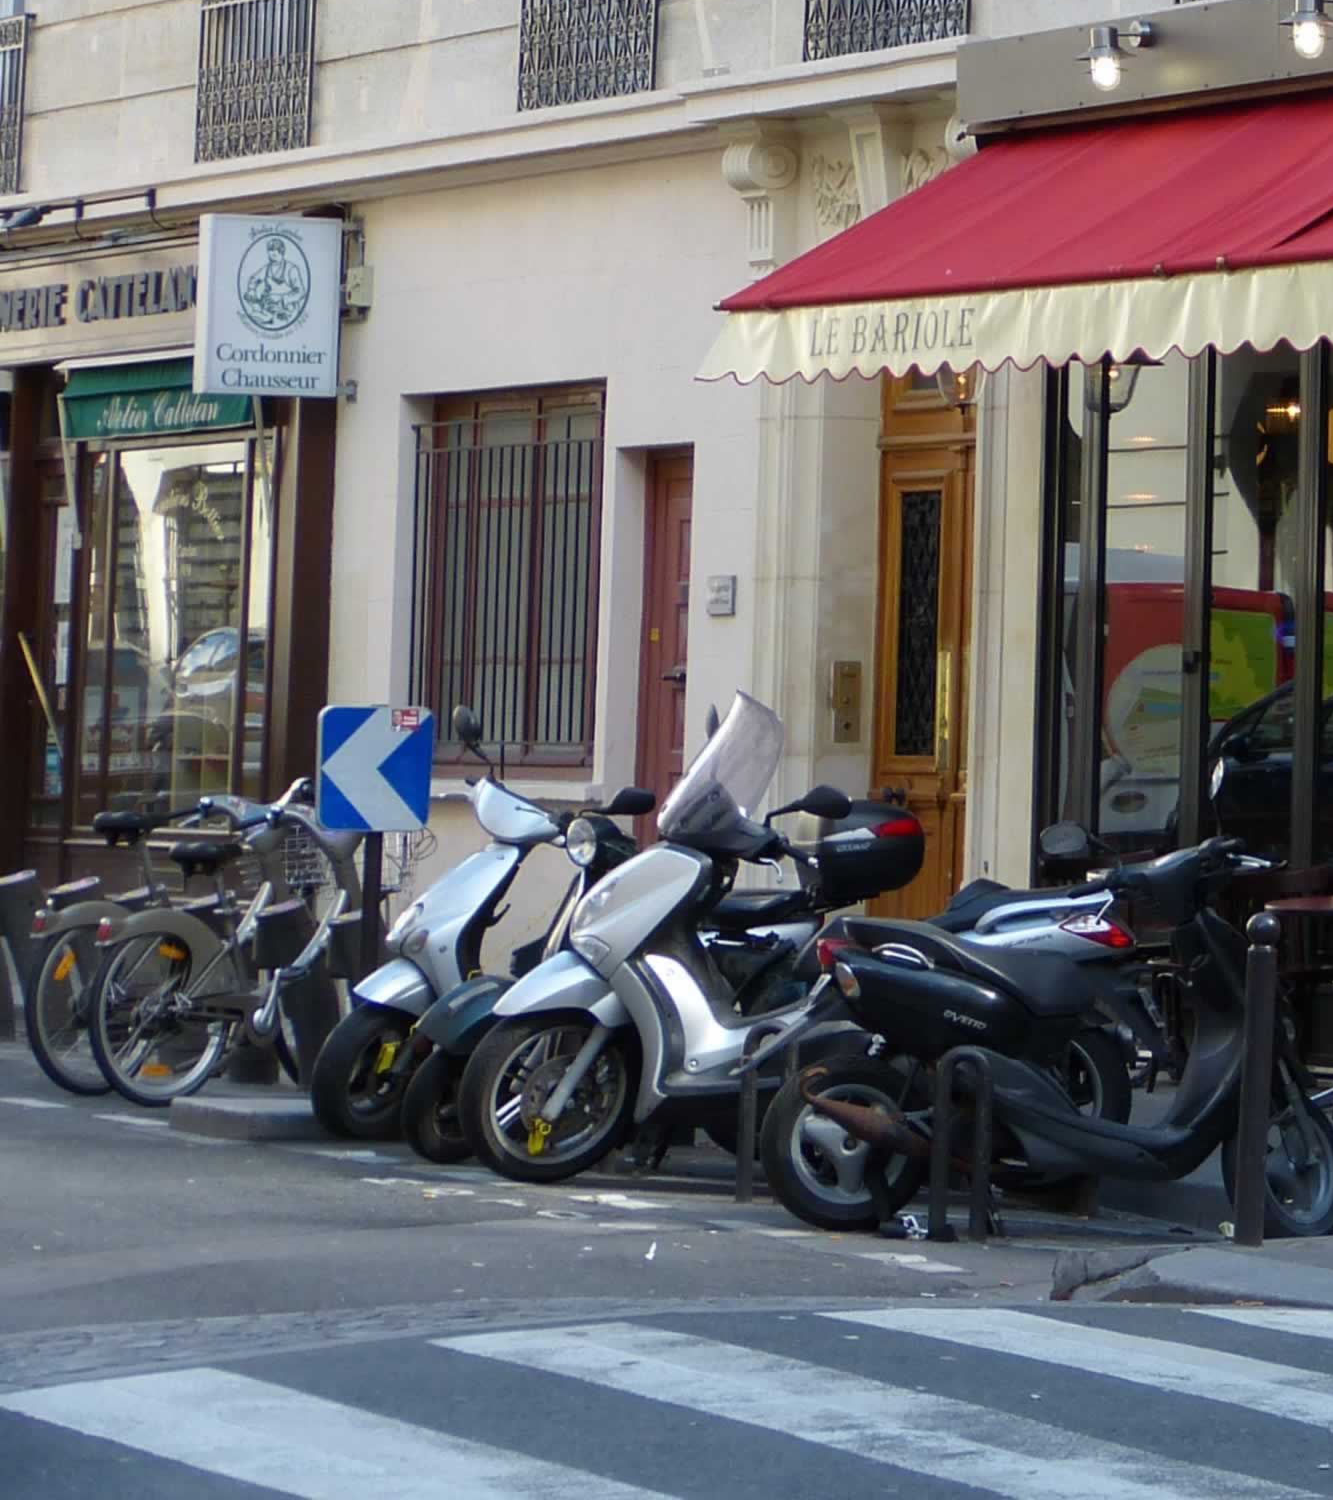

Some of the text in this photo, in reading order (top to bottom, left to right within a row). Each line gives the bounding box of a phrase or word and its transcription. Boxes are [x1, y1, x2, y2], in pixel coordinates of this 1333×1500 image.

[810, 317, 840, 357] LE
[216, 342, 326, 364] Cordonnier
[221, 367, 319, 389] Chausseur
[97, 393, 149, 429] Atelier
